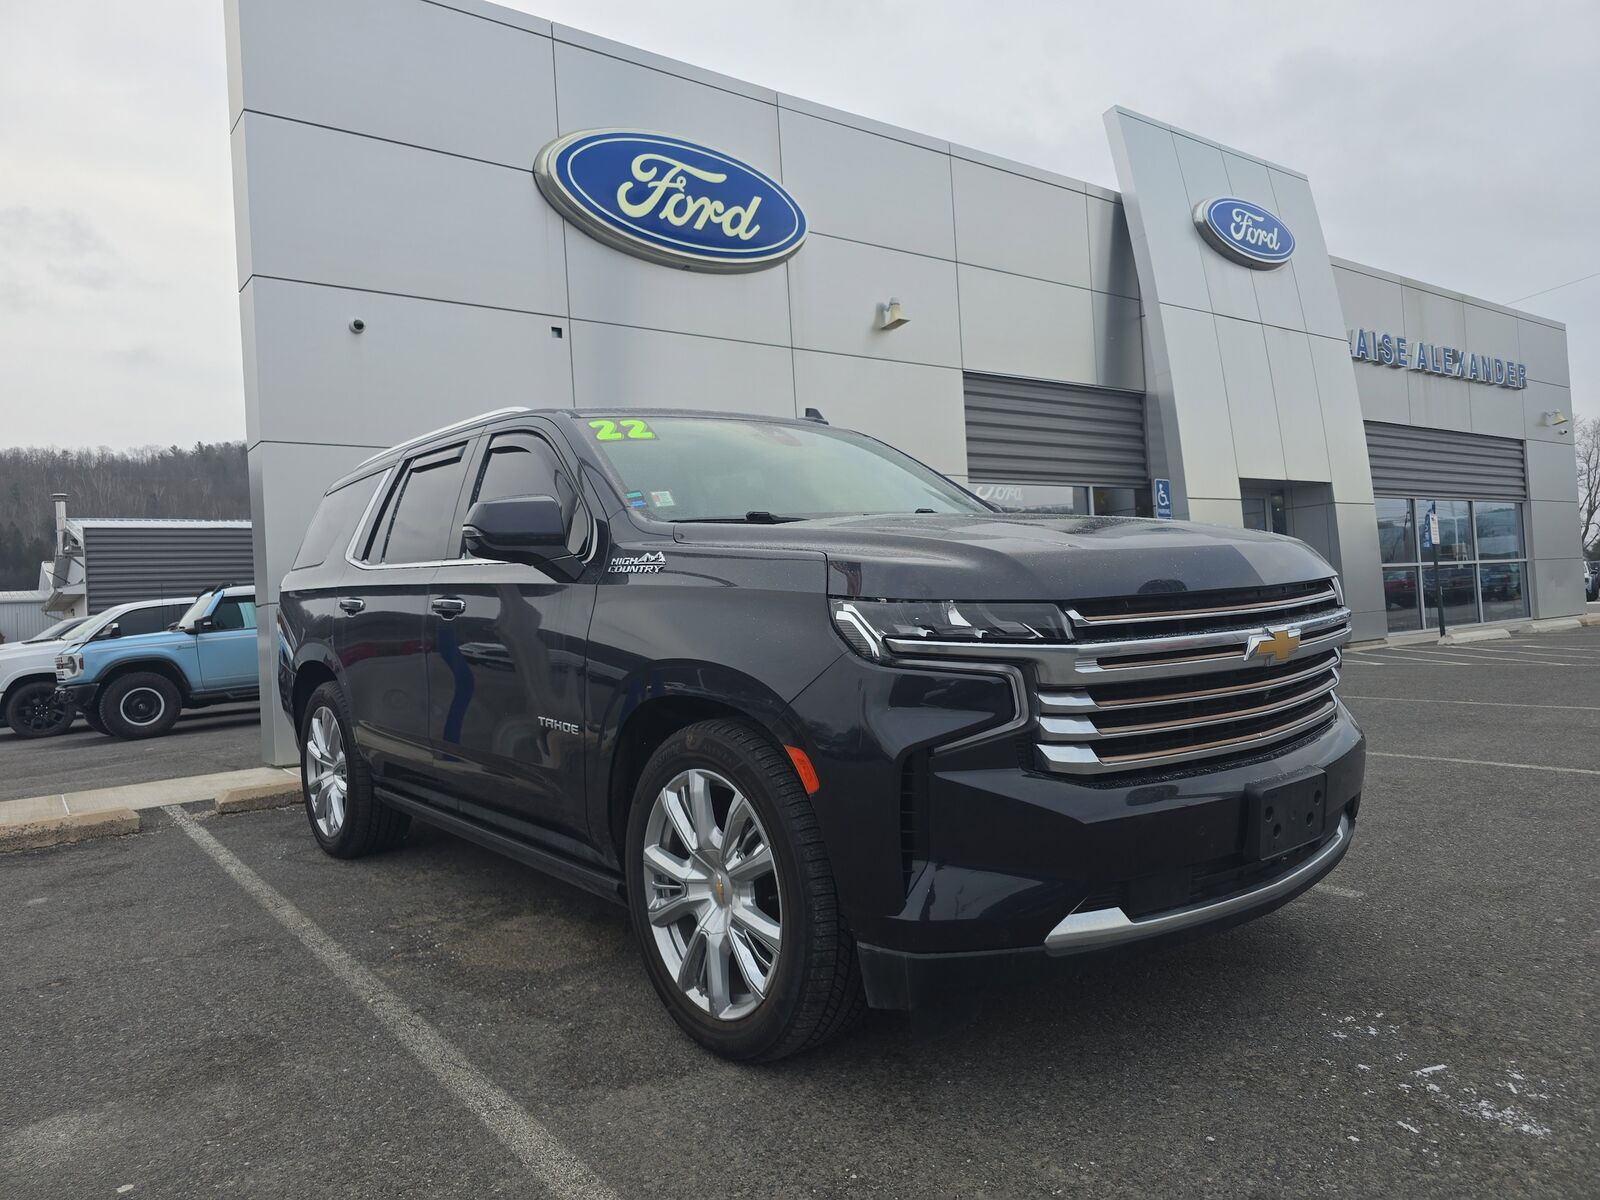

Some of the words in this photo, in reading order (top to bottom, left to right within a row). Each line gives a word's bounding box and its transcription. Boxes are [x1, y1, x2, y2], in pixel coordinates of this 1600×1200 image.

[617, 153, 762, 240] Ford
[1230, 208, 1280, 250] Ford
[1412, 342, 1527, 389] ALEXANDER
[588, 419, 656, 440] 22
[608, 565, 661, 573] COUNTRY
[611, 557, 640, 565] HIGH
[537, 716, 579, 735] TAHOE
